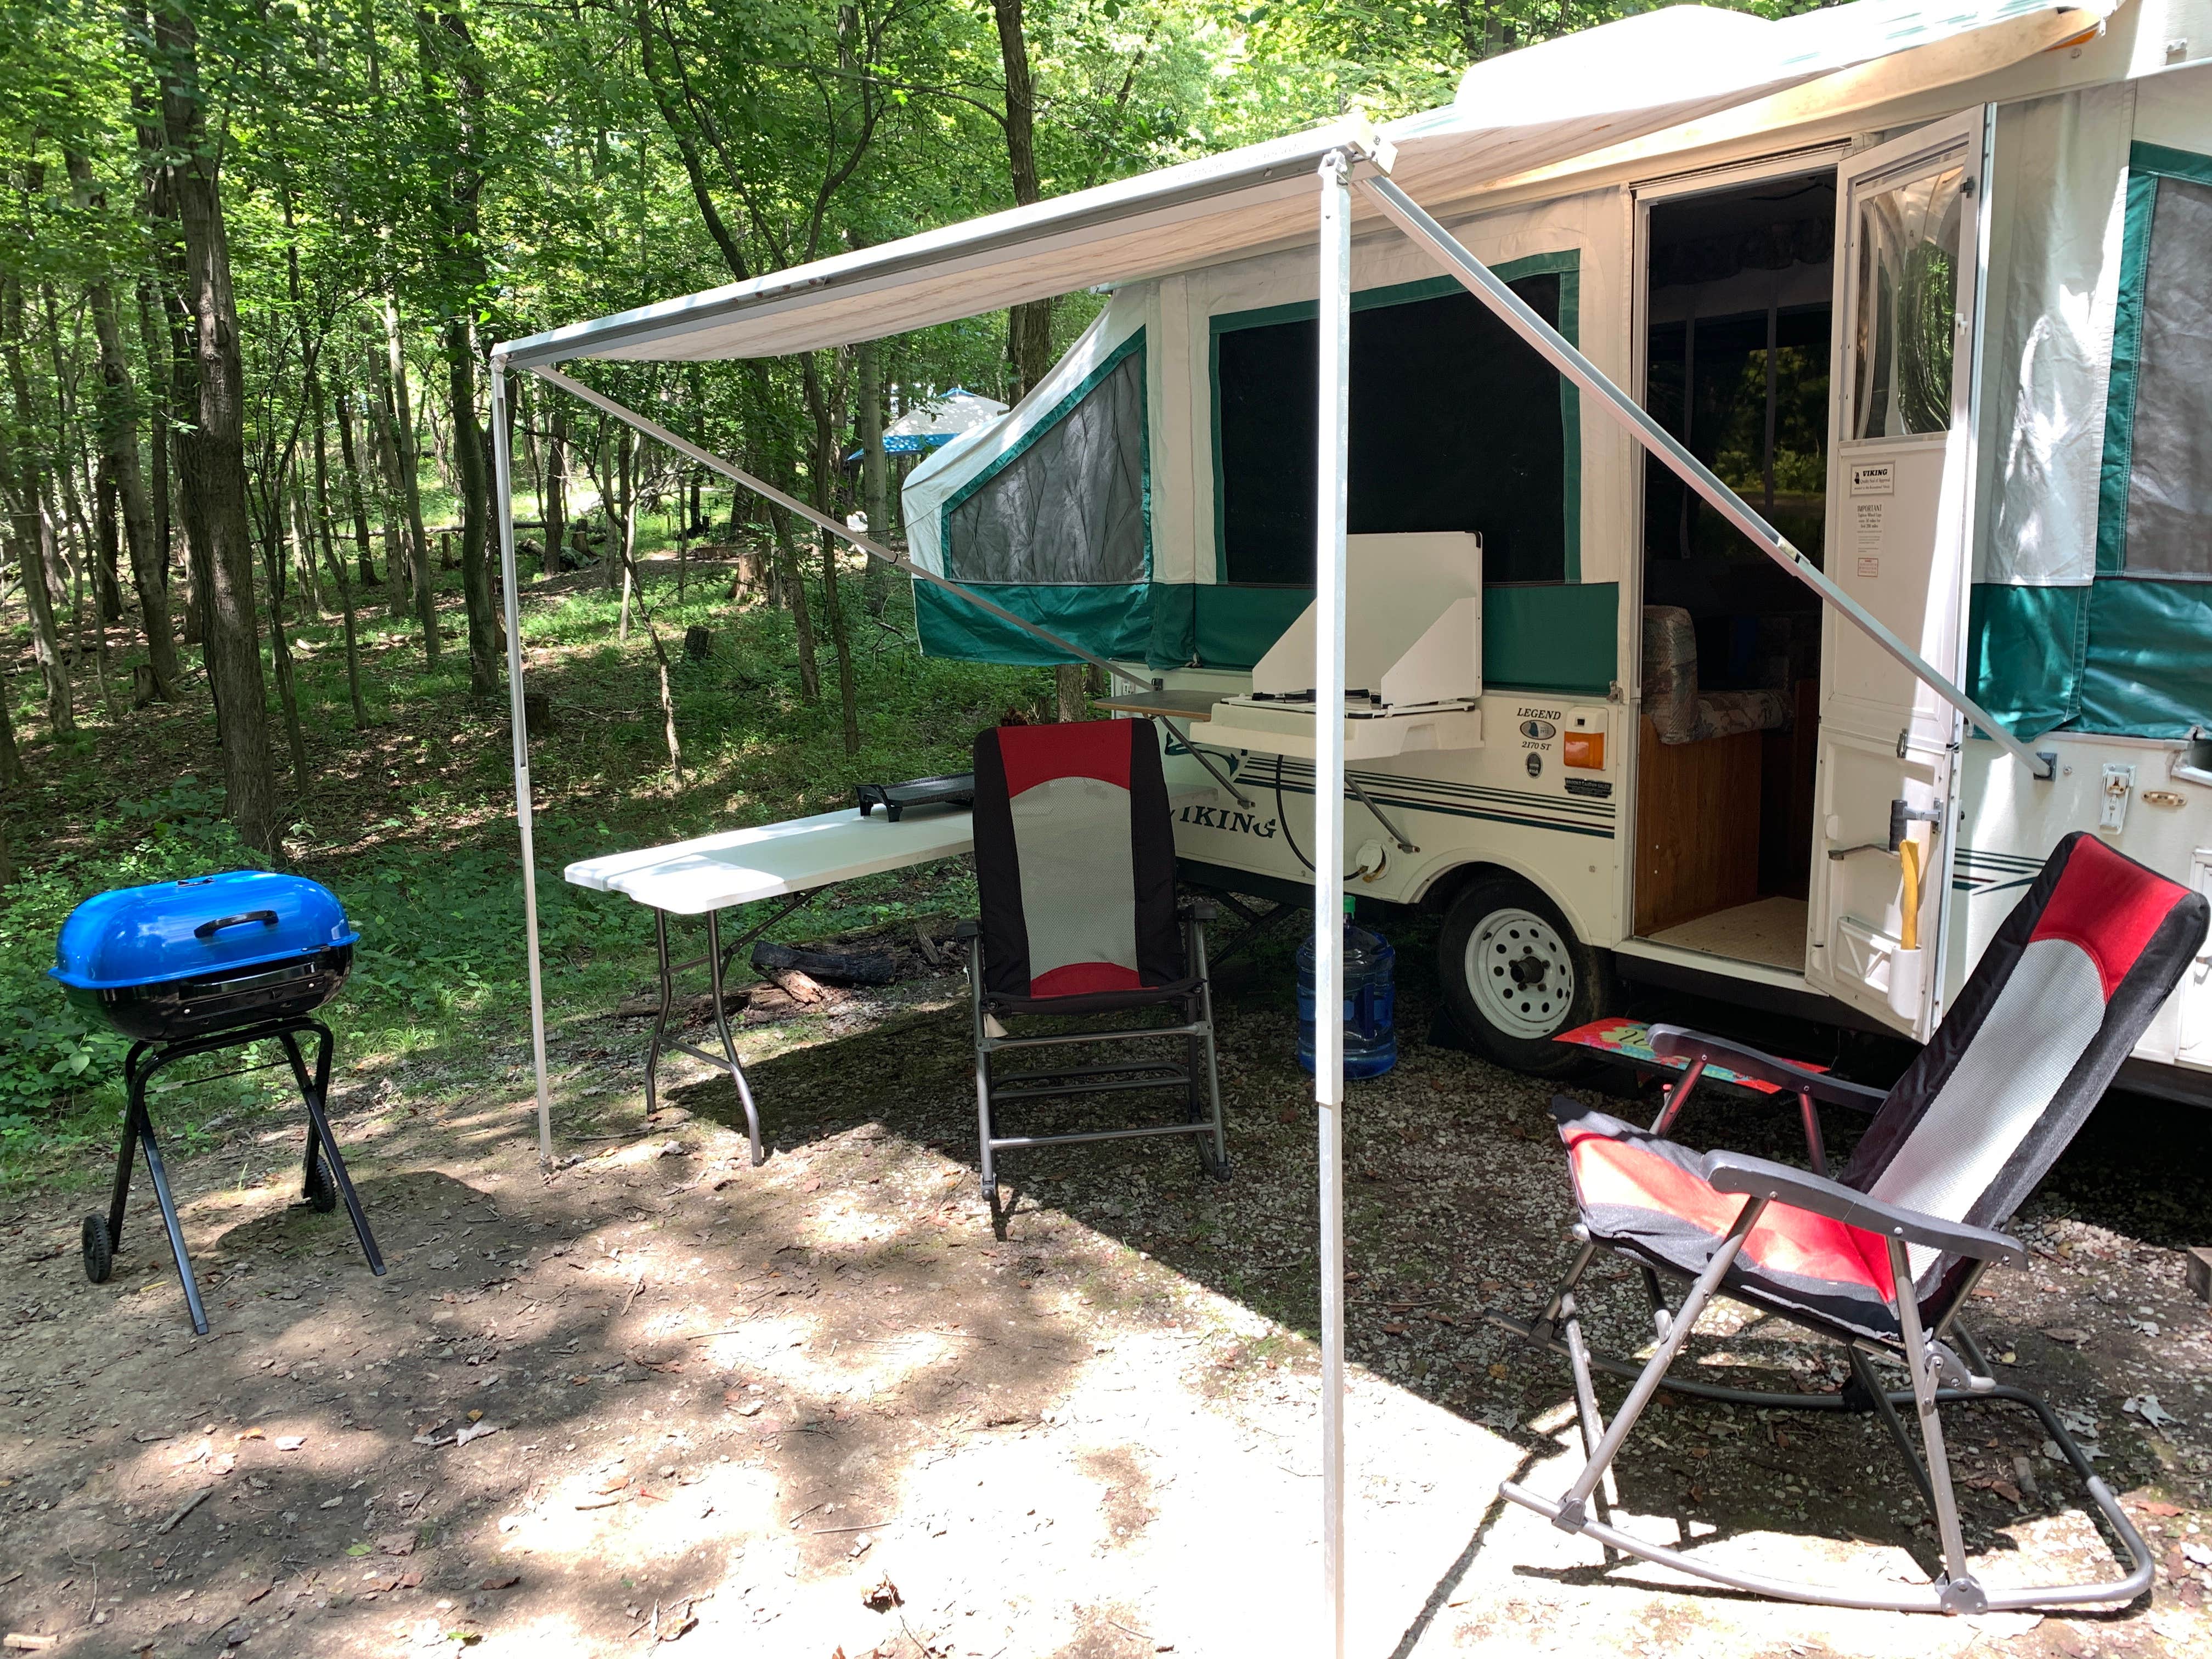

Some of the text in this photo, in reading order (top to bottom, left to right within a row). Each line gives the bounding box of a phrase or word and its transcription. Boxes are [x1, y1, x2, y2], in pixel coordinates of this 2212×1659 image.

[1863, 469, 1888, 477] VIKING
[1857, 504, 1882, 512] IMPORTANT
[1517, 707, 1561, 720] LEGEND
[1521, 741, 1539, 749] 2170
[1170, 805, 1277, 838] IKING
